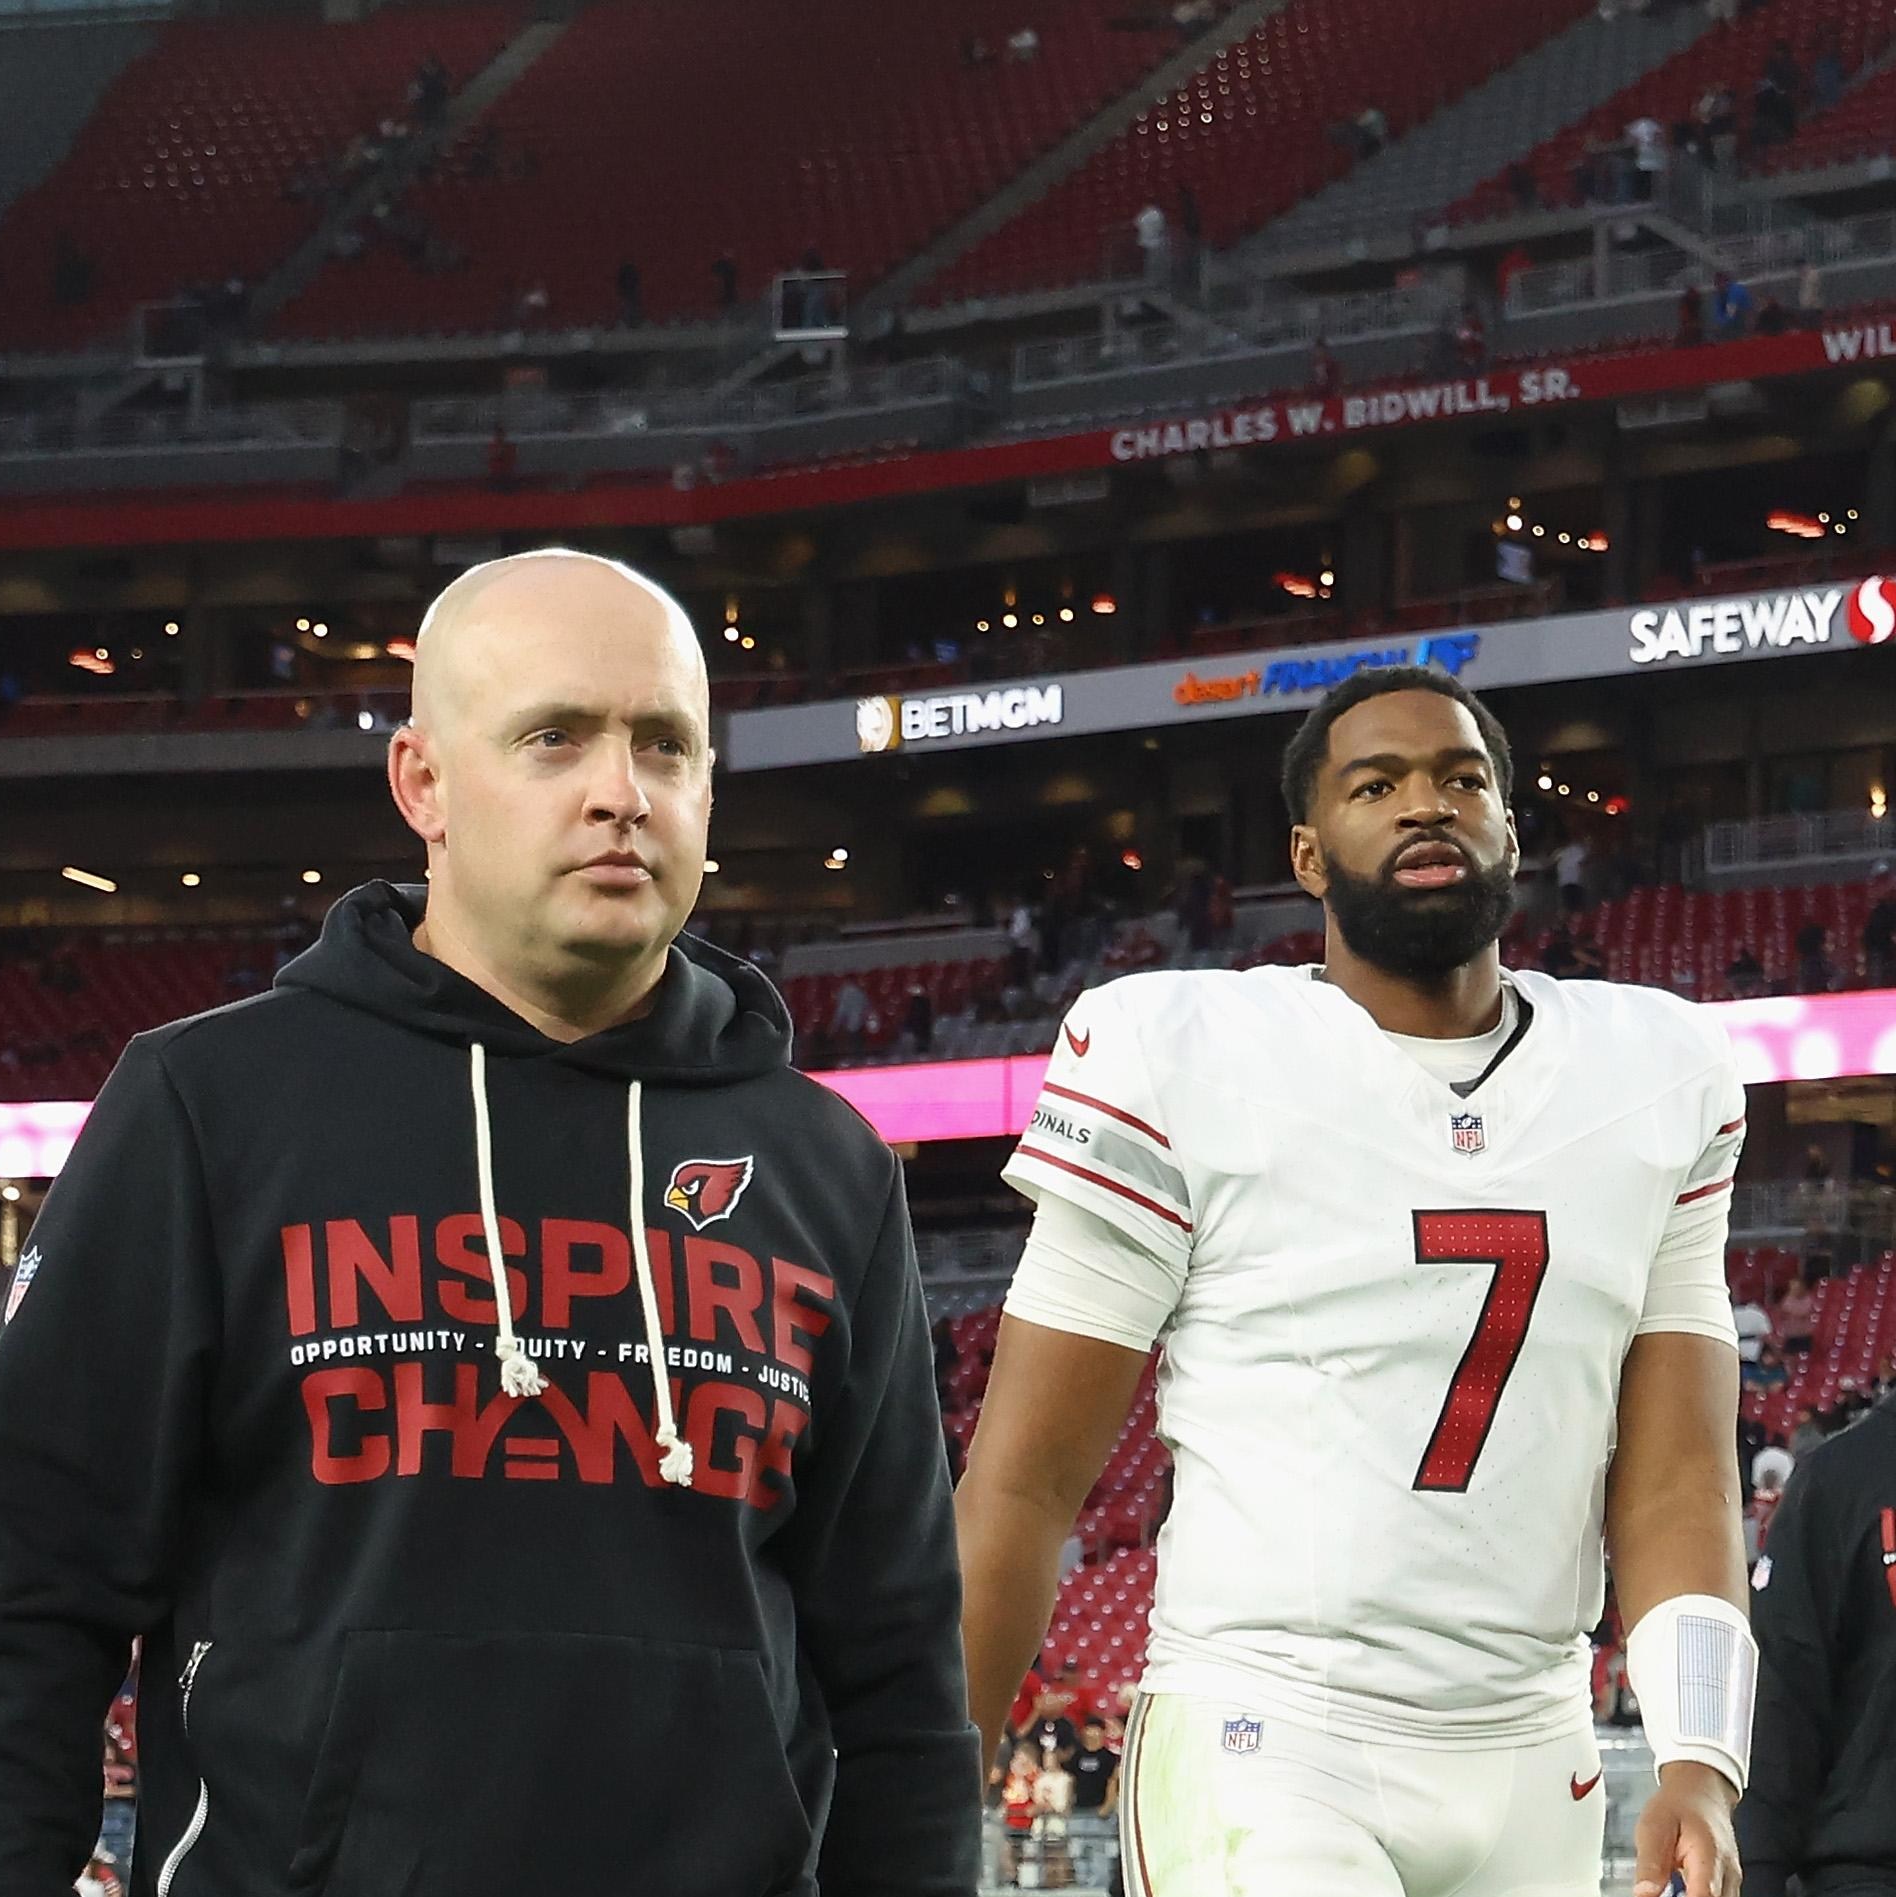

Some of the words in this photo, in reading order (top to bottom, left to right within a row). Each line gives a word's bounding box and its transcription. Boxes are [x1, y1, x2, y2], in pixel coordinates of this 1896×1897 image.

[1109, 408, 1280, 462] CHARLES
[1286, 402, 1335, 436] W.
[1342, 378, 1511, 430] BIDWILL,
[1519, 368, 1581, 404] SR.
[1628, 588, 1844, 665] SAFEWAY
[902, 684, 1064, 741] BETMGM
[1455, 1130, 1483, 1150] NFL
[280, 1214, 836, 1374] INSPIRE
[291, 1330, 466, 1367] OPPORTUNITY
[495, 1336, 587, 1361] UITY
[617, 1343, 734, 1375] FREDOM
[758, 1364, 813, 1407] JUSTIC
[1410, 1208, 1550, 1494] 7
[300, 1361, 812, 1510] CHANGE
[1227, 1732, 1256, 1750] NFL
